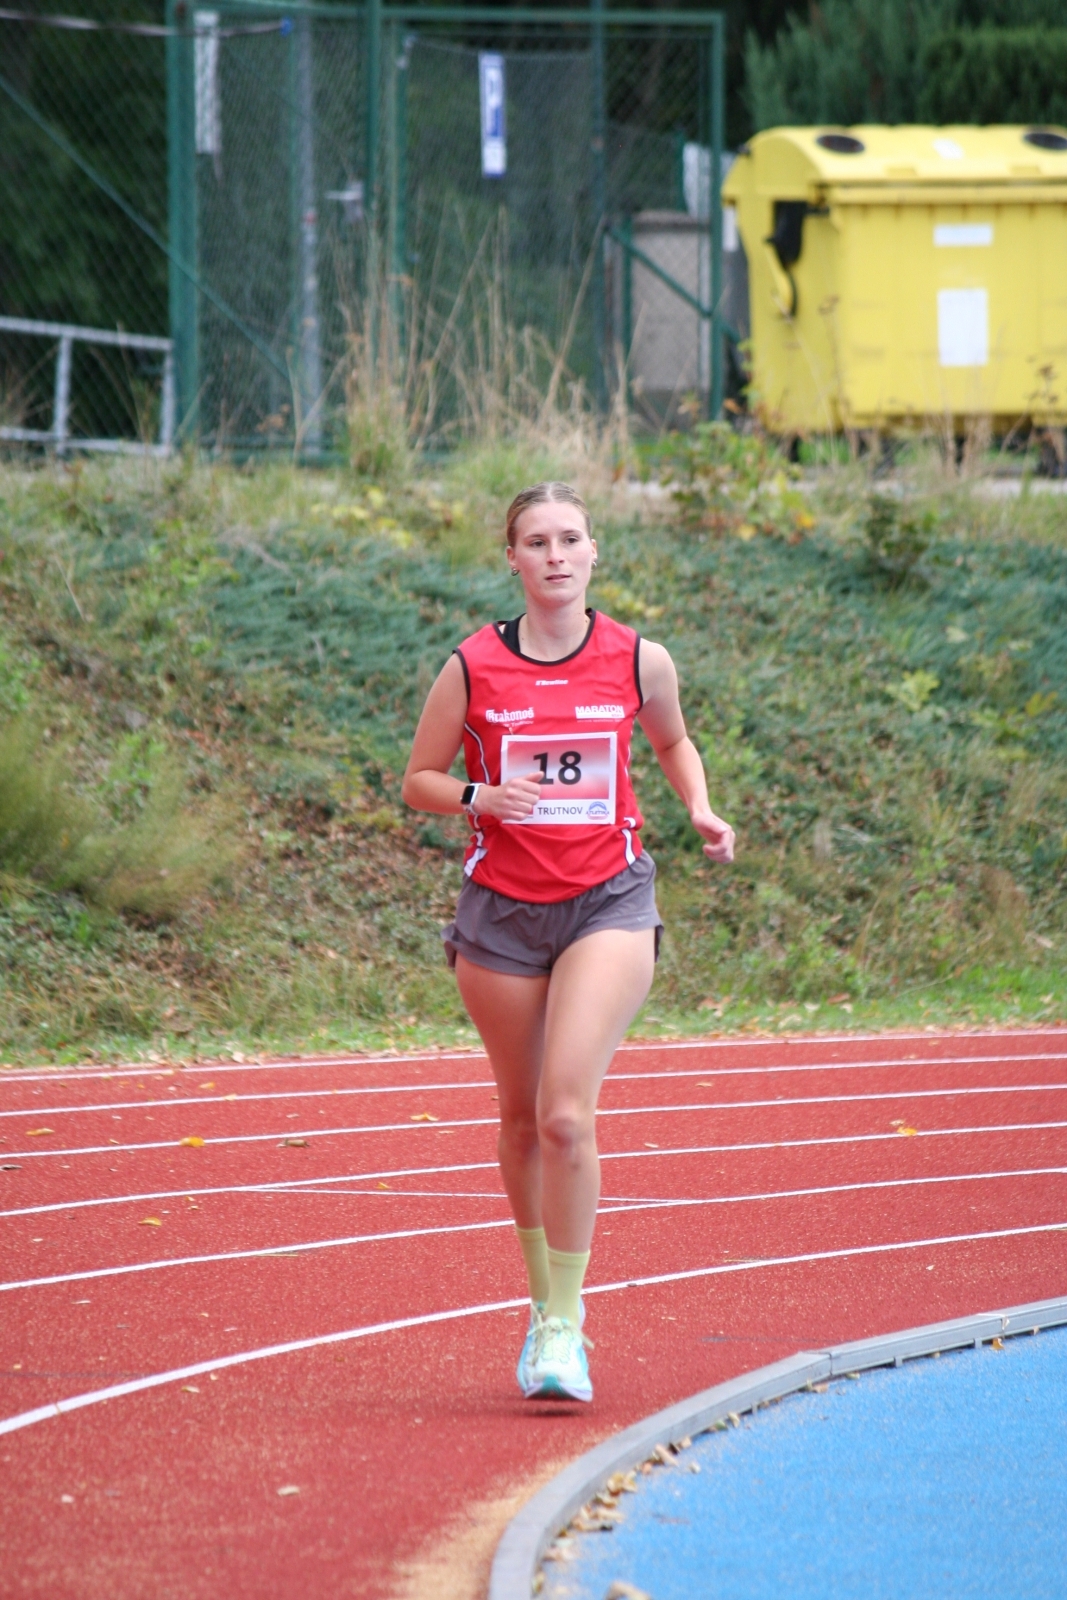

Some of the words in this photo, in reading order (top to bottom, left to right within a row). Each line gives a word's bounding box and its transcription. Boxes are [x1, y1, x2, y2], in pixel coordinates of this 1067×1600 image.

[575, 705, 624, 714] MARATON
[533, 750, 582, 785] 18
[537, 806, 584, 816] TRUTNOV
